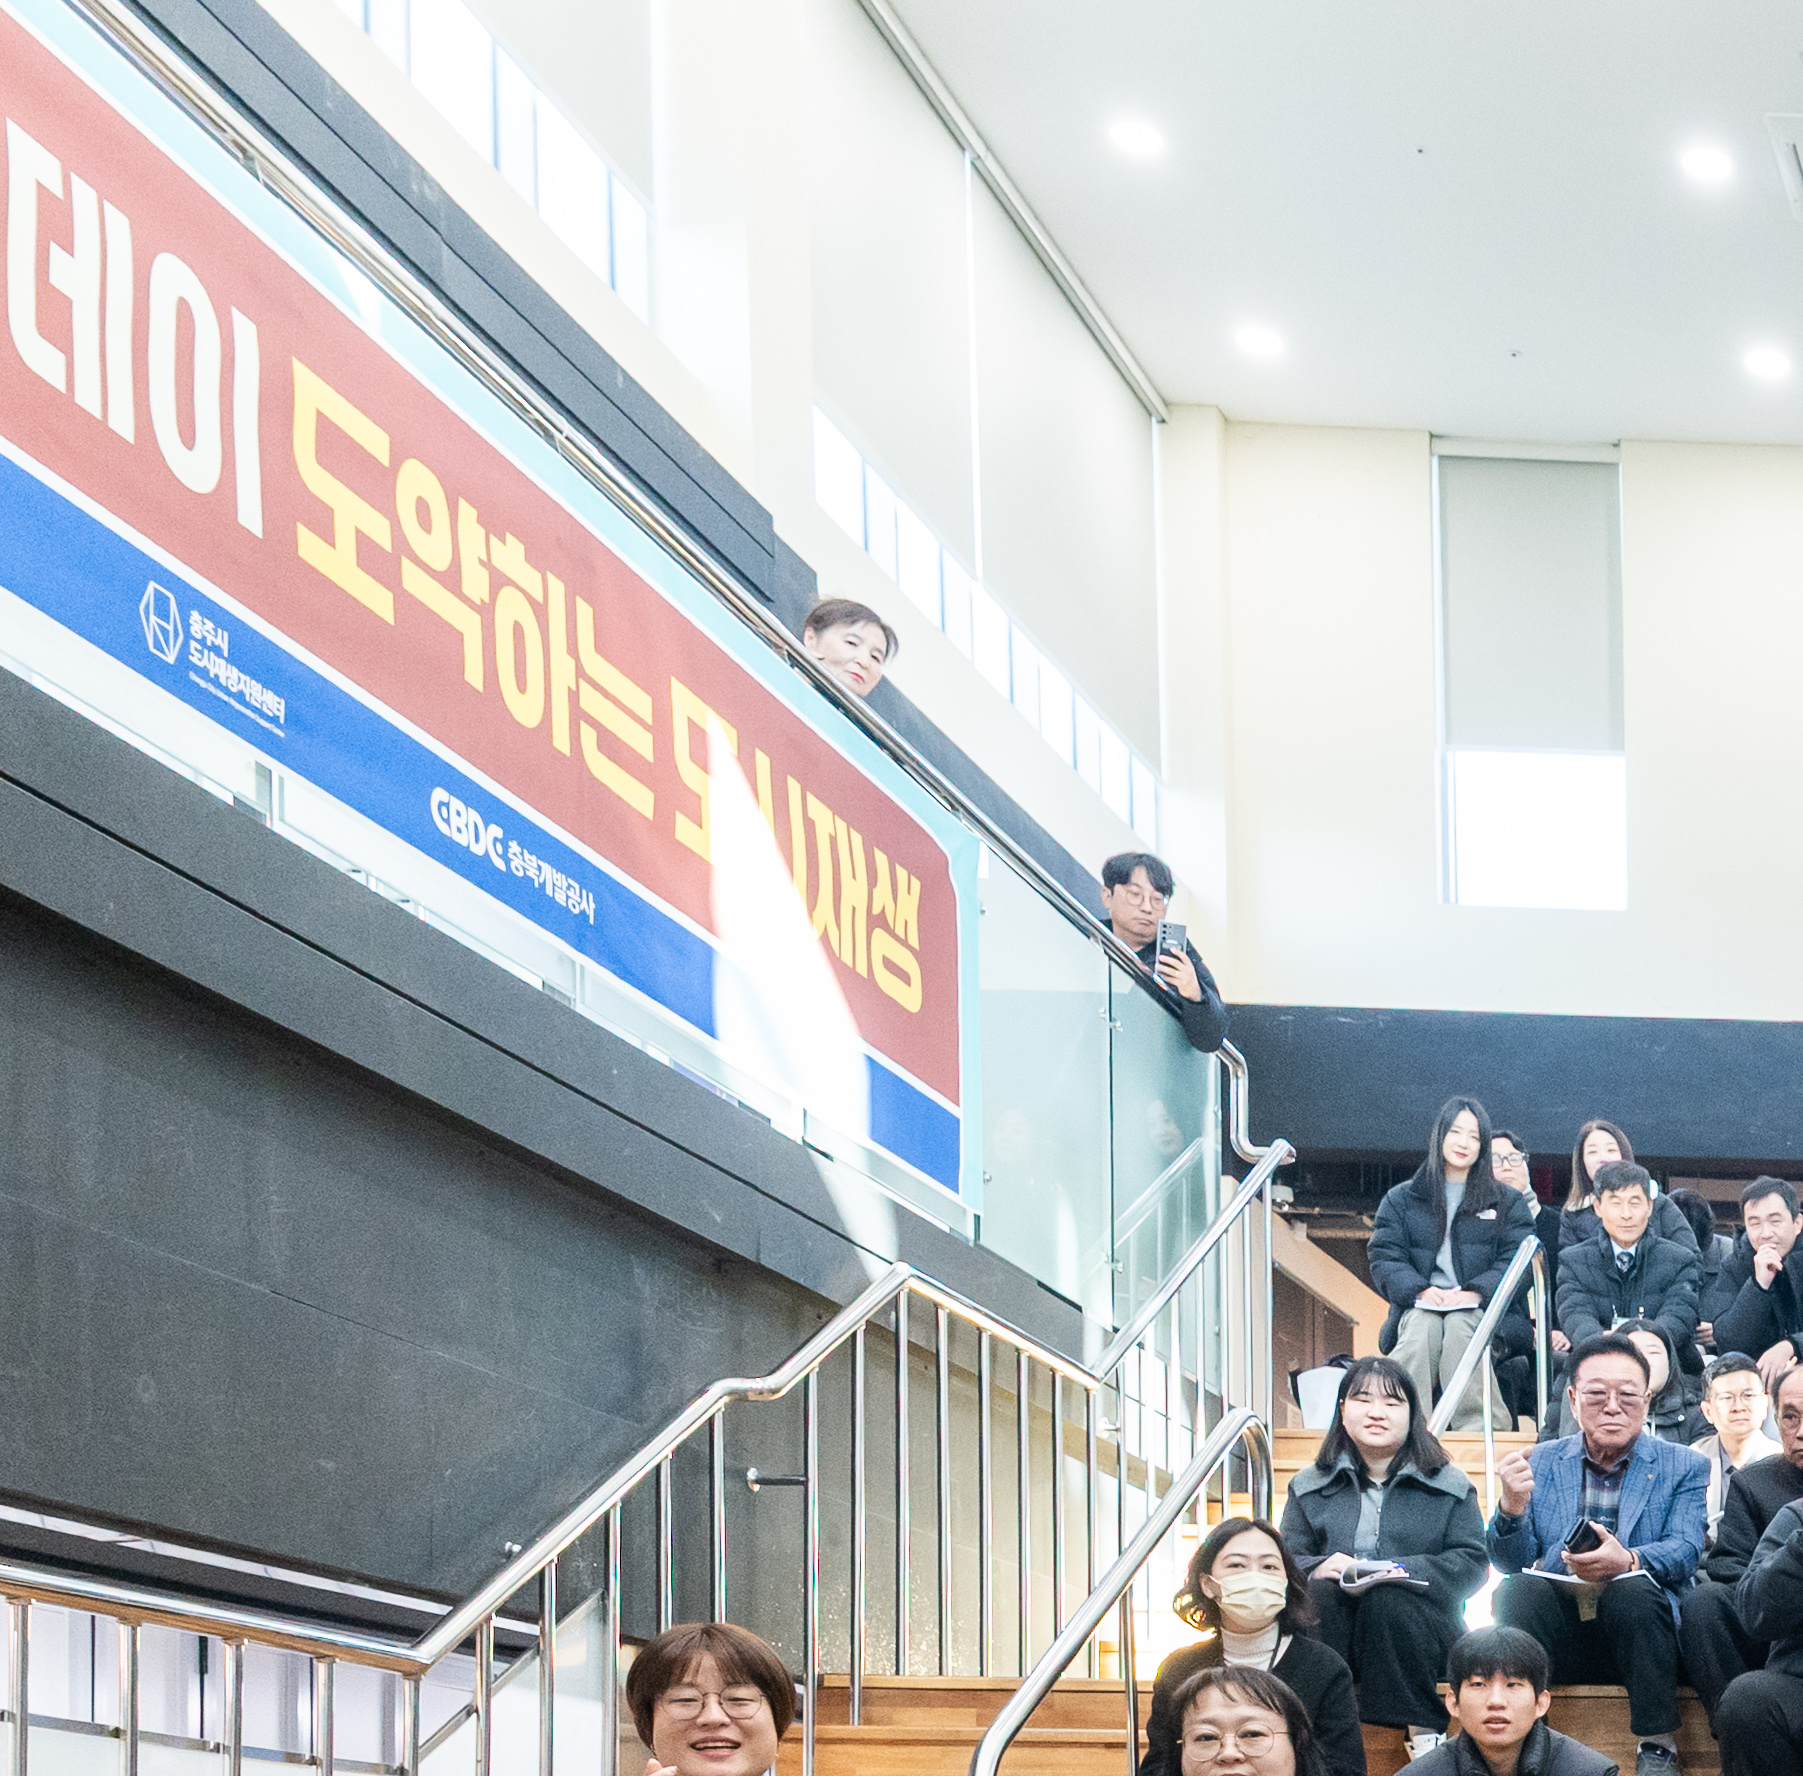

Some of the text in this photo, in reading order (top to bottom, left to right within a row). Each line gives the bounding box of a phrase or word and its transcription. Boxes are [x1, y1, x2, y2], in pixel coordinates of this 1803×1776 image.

[5, 115, 263, 540] 데이
[291, 355, 656, 821] 도약하는
[188, 609, 229, 658] 충주시
[188, 639, 286, 724] 도시재생지원센터
[508, 839, 596, 925] 충북개발공사
